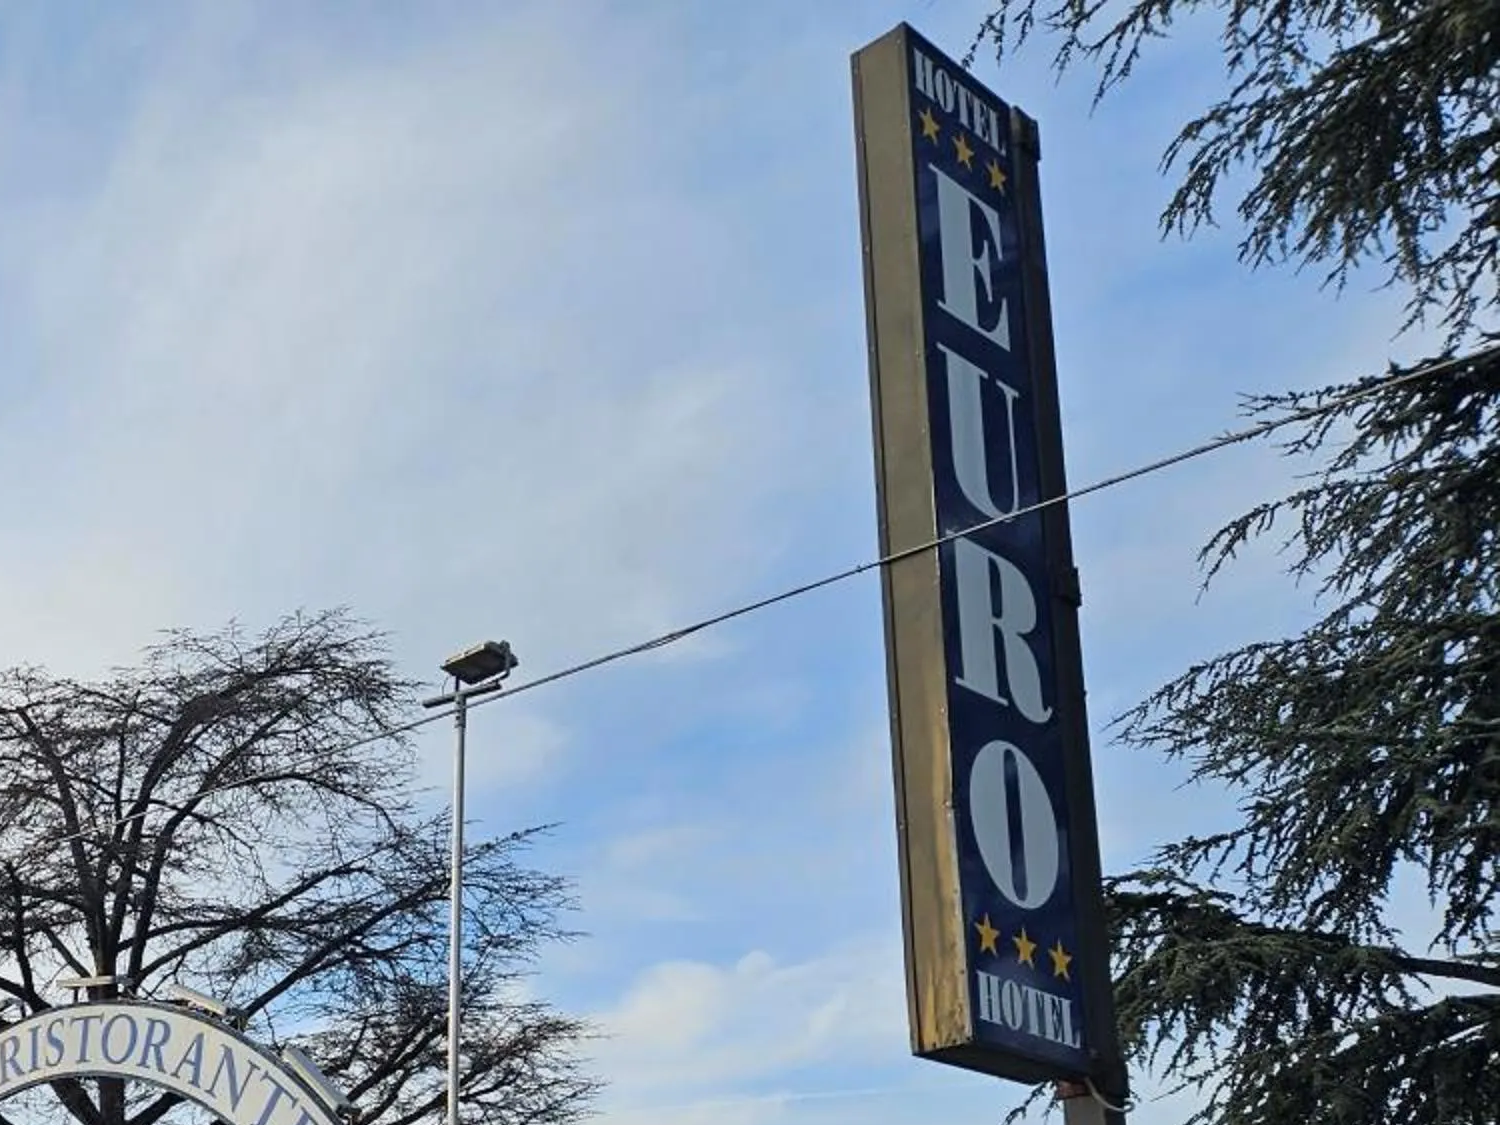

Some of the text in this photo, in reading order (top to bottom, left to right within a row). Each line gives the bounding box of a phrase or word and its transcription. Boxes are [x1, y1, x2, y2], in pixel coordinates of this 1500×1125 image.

[914, 49, 1007, 156] HOTEL
[928, 163, 1059, 910] EURO
[977, 972, 1080, 1048] HOTEL
